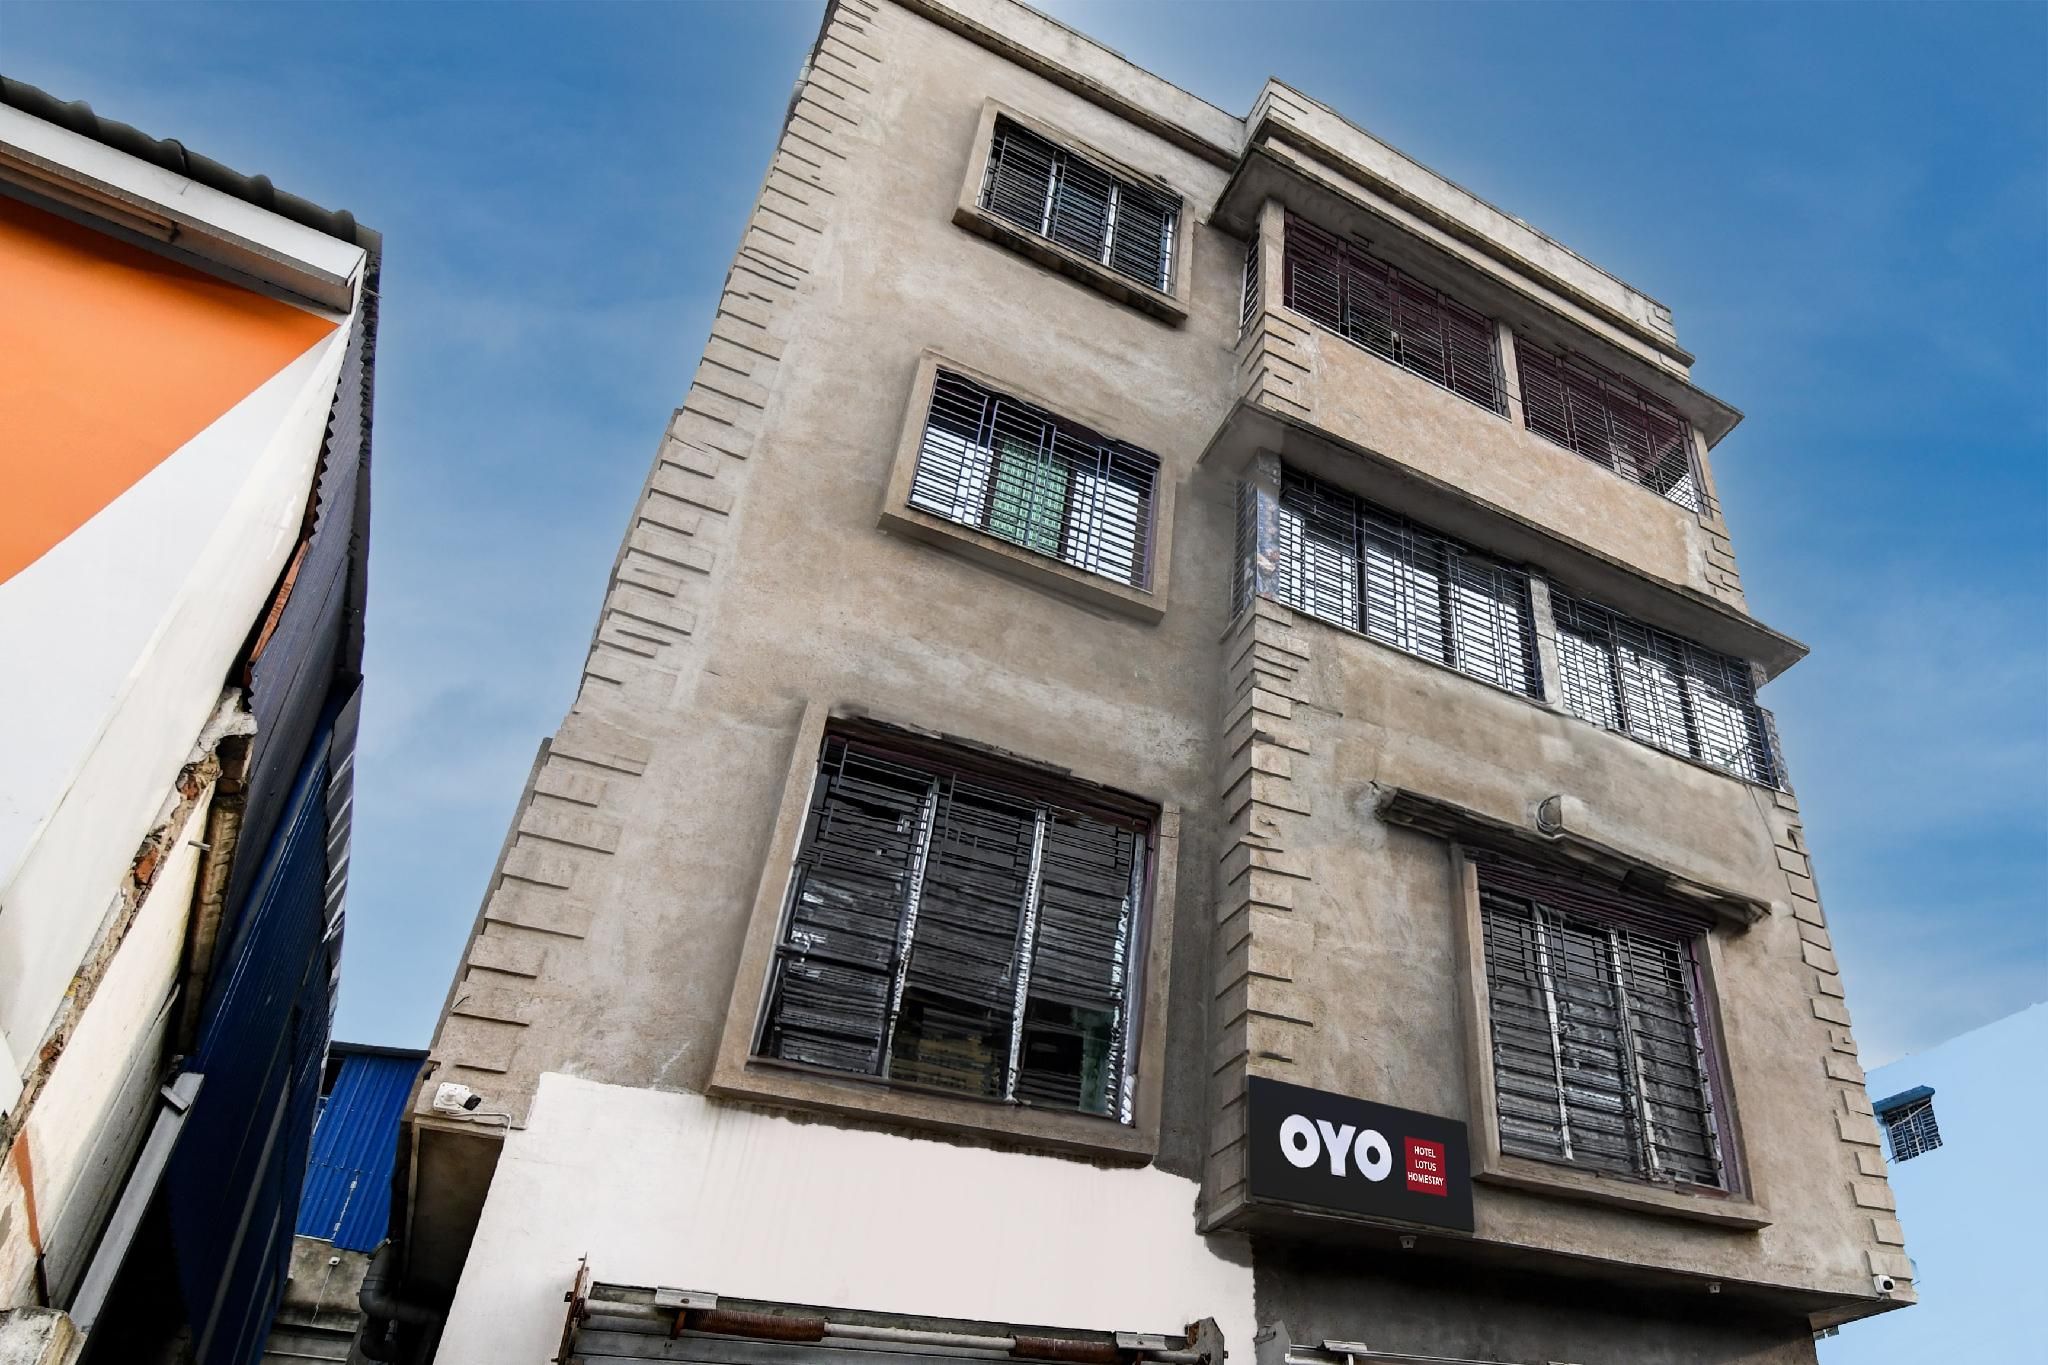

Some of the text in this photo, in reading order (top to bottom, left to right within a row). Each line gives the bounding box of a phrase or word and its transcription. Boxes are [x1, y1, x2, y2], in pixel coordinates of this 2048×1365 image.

[1279, 1114, 1392, 1182] OYO
[1414, 1146, 1436, 1158] HOTEL
[1415, 1160, 1437, 1171] LOTUS
[1407, 1172, 1444, 1186] HOMESTAY
